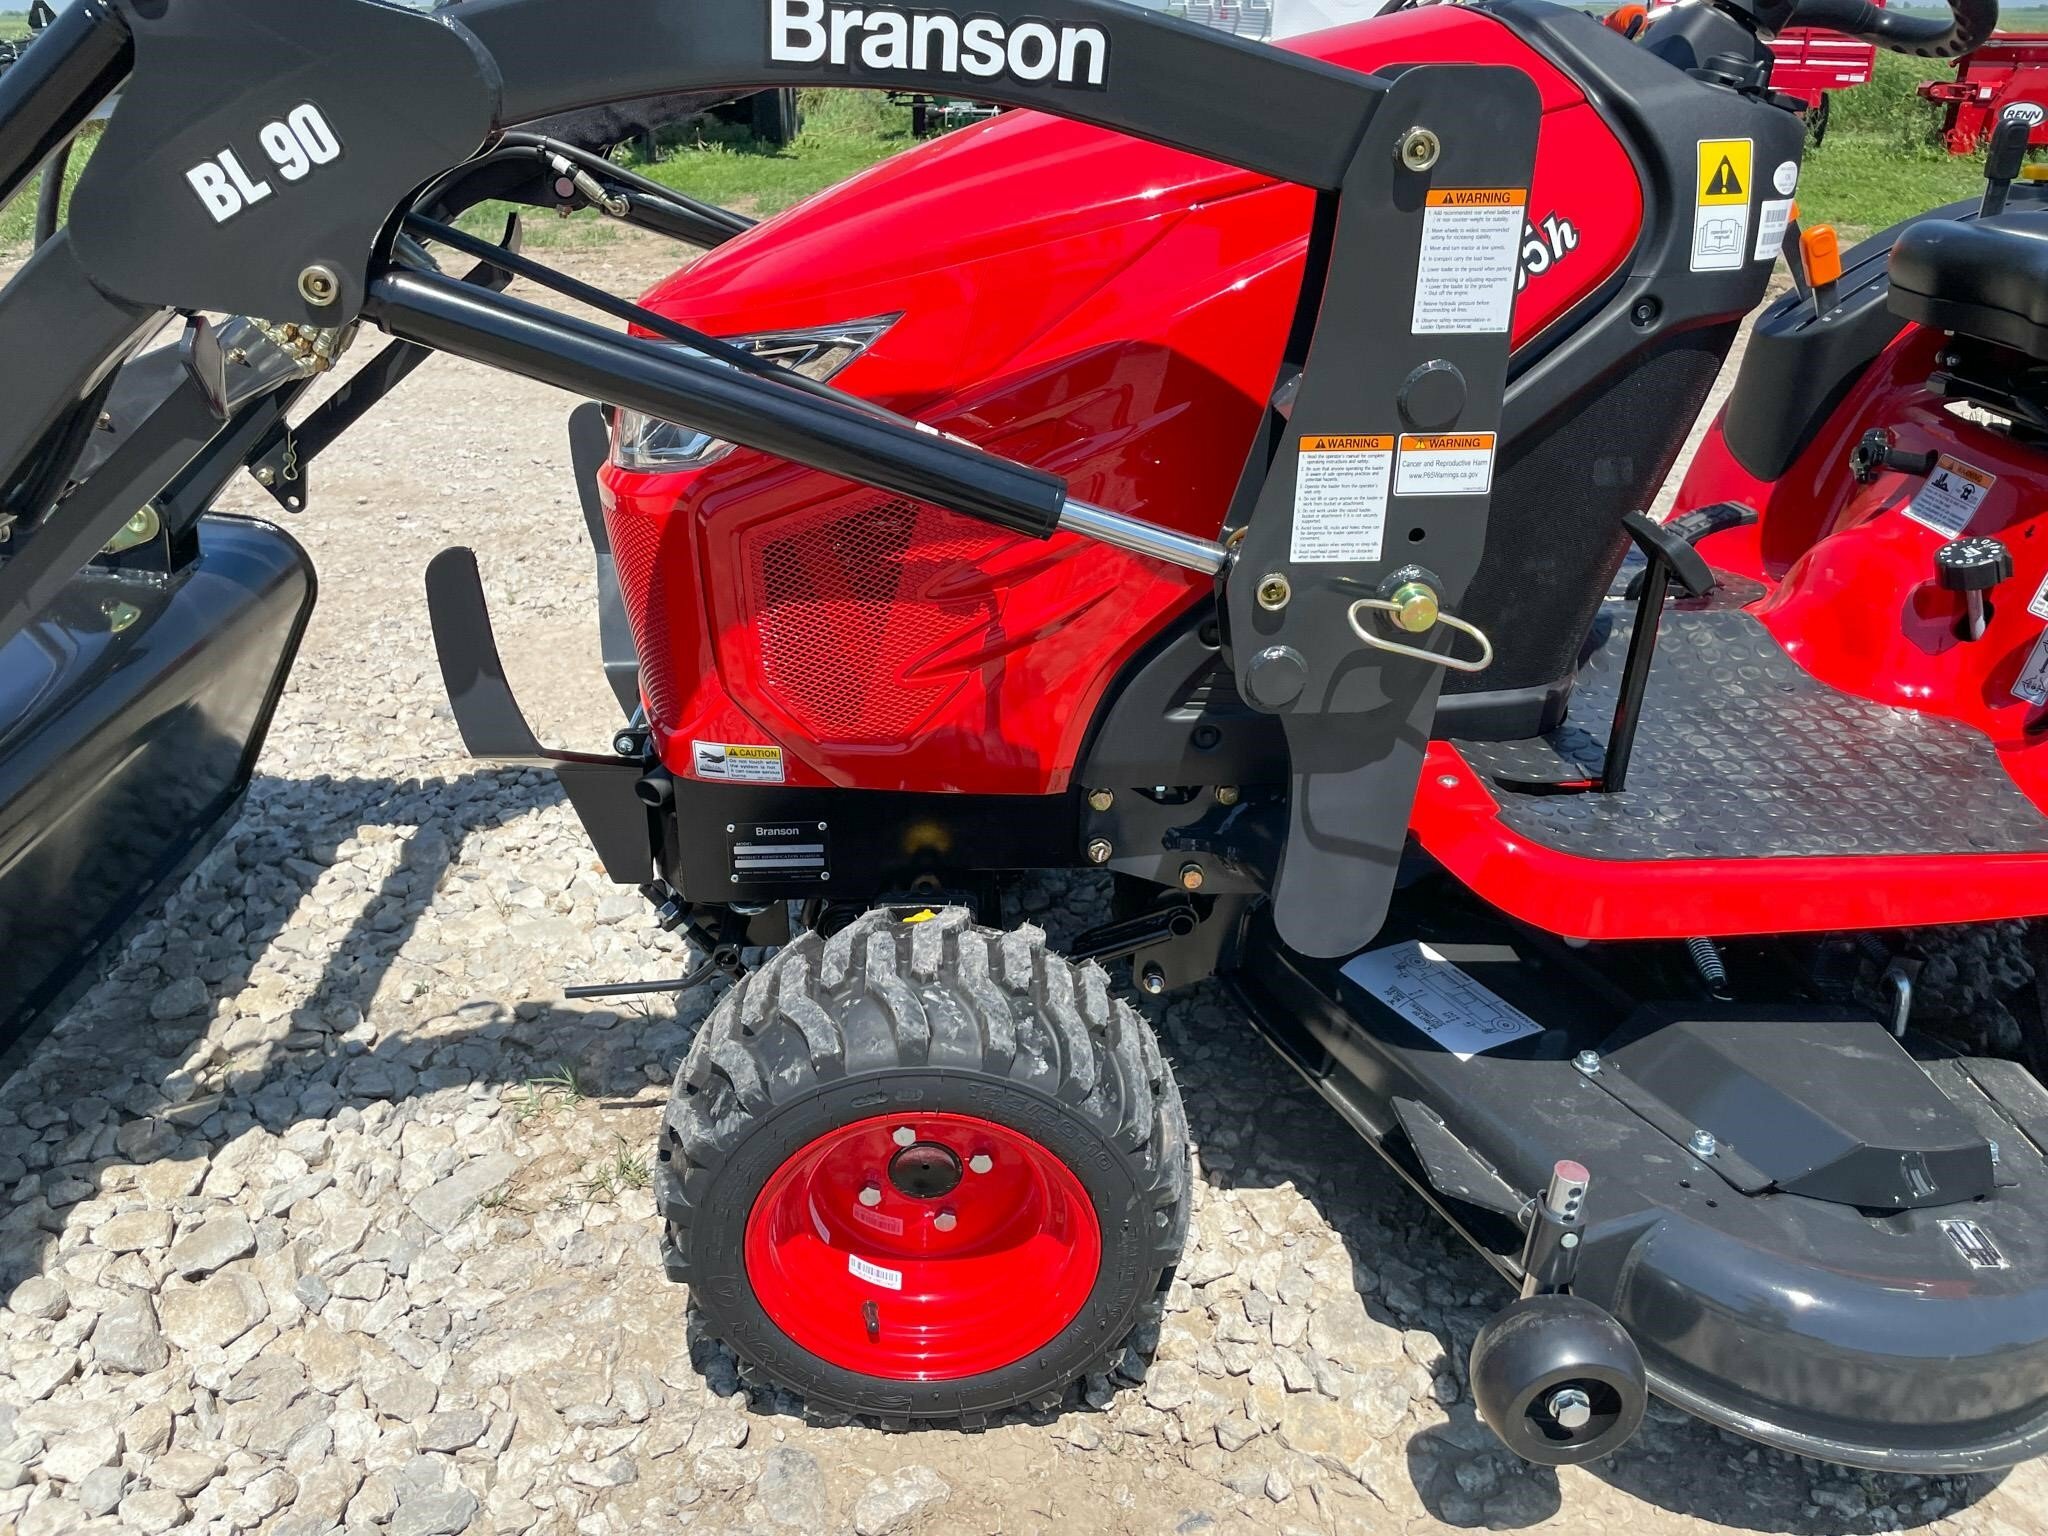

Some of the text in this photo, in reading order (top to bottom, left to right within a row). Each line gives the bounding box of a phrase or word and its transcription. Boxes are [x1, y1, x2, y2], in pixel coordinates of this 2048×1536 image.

[770, 0, 1106, 85] Branson
[186, 104, 340, 222] BL 90
[1455, 192, 1511, 204] WARNING
[1517, 217, 1577, 290] 5h
[1328, 438, 1379, 448] WARNING
[1429, 438, 1480, 448] WARNING
[1402, 460, 1422, 468] Cancer
[1435, 459, 1471, 468] Reproductive
[739, 749, 777, 757] CAUTION
[755, 827, 800, 836] Branson
